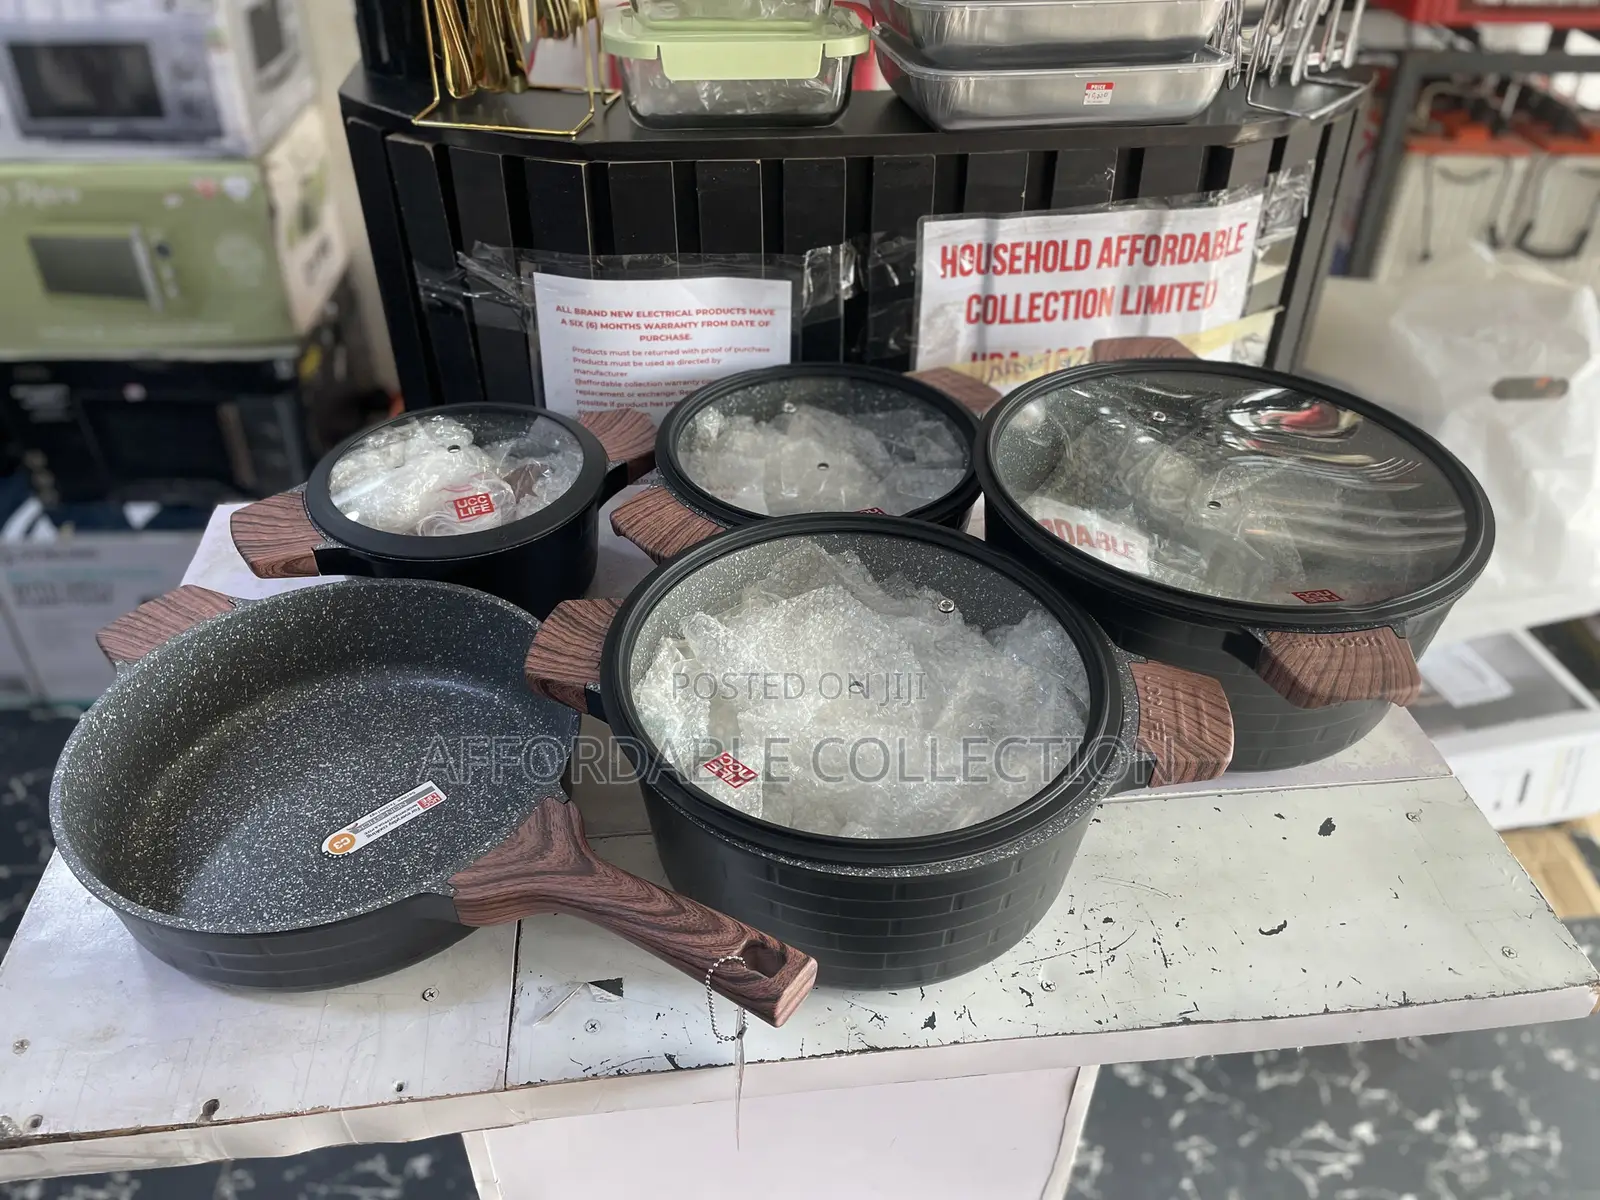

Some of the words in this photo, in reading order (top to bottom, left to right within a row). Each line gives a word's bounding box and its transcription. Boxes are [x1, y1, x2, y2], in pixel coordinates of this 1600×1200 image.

[940, 239, 1092, 279] HOUSEHOLD
[1096, 222, 1248, 269] AFFORDABLE
[966, 285, 1116, 325] COLLECTION
[1121, 280, 1218, 317] LIMITED
[555, 305, 572, 314] ALL
[574, 307, 608, 317] BRAND
[610, 310, 634, 318] NEW
[636, 309, 693, 318] ELECTRICAL
[696, 308, 747, 316] PRODUCTS
[749, 308, 775, 316] HAVE
[569, 319, 584, 327] SIX
[586, 321, 598, 330] (6)
[643, 322, 699, 330] WARRANTY
[701, 320, 728, 328] FROM
[572, 346, 607, 356] Products
[681, 347, 700, 355] with
[701, 346, 722, 356] proof
[734, 346, 770, 355] purchase
[573, 357, 608, 366] Products
[677, 358, 710, 366] directed
[711, 357, 721, 365] by
[573, 368, 628, 377] manufacturer
[624, 380, 662, 388] collection
[664, 379, 700, 388] warranty
[576, 389, 625, 397] replacement
[577, 399, 608, 407] possible
[616, 400, 648, 408] product
[456, 495, 488, 508] UCC
[459, 502, 491, 517] LIFE
[333, 837, 351, 849] C3
